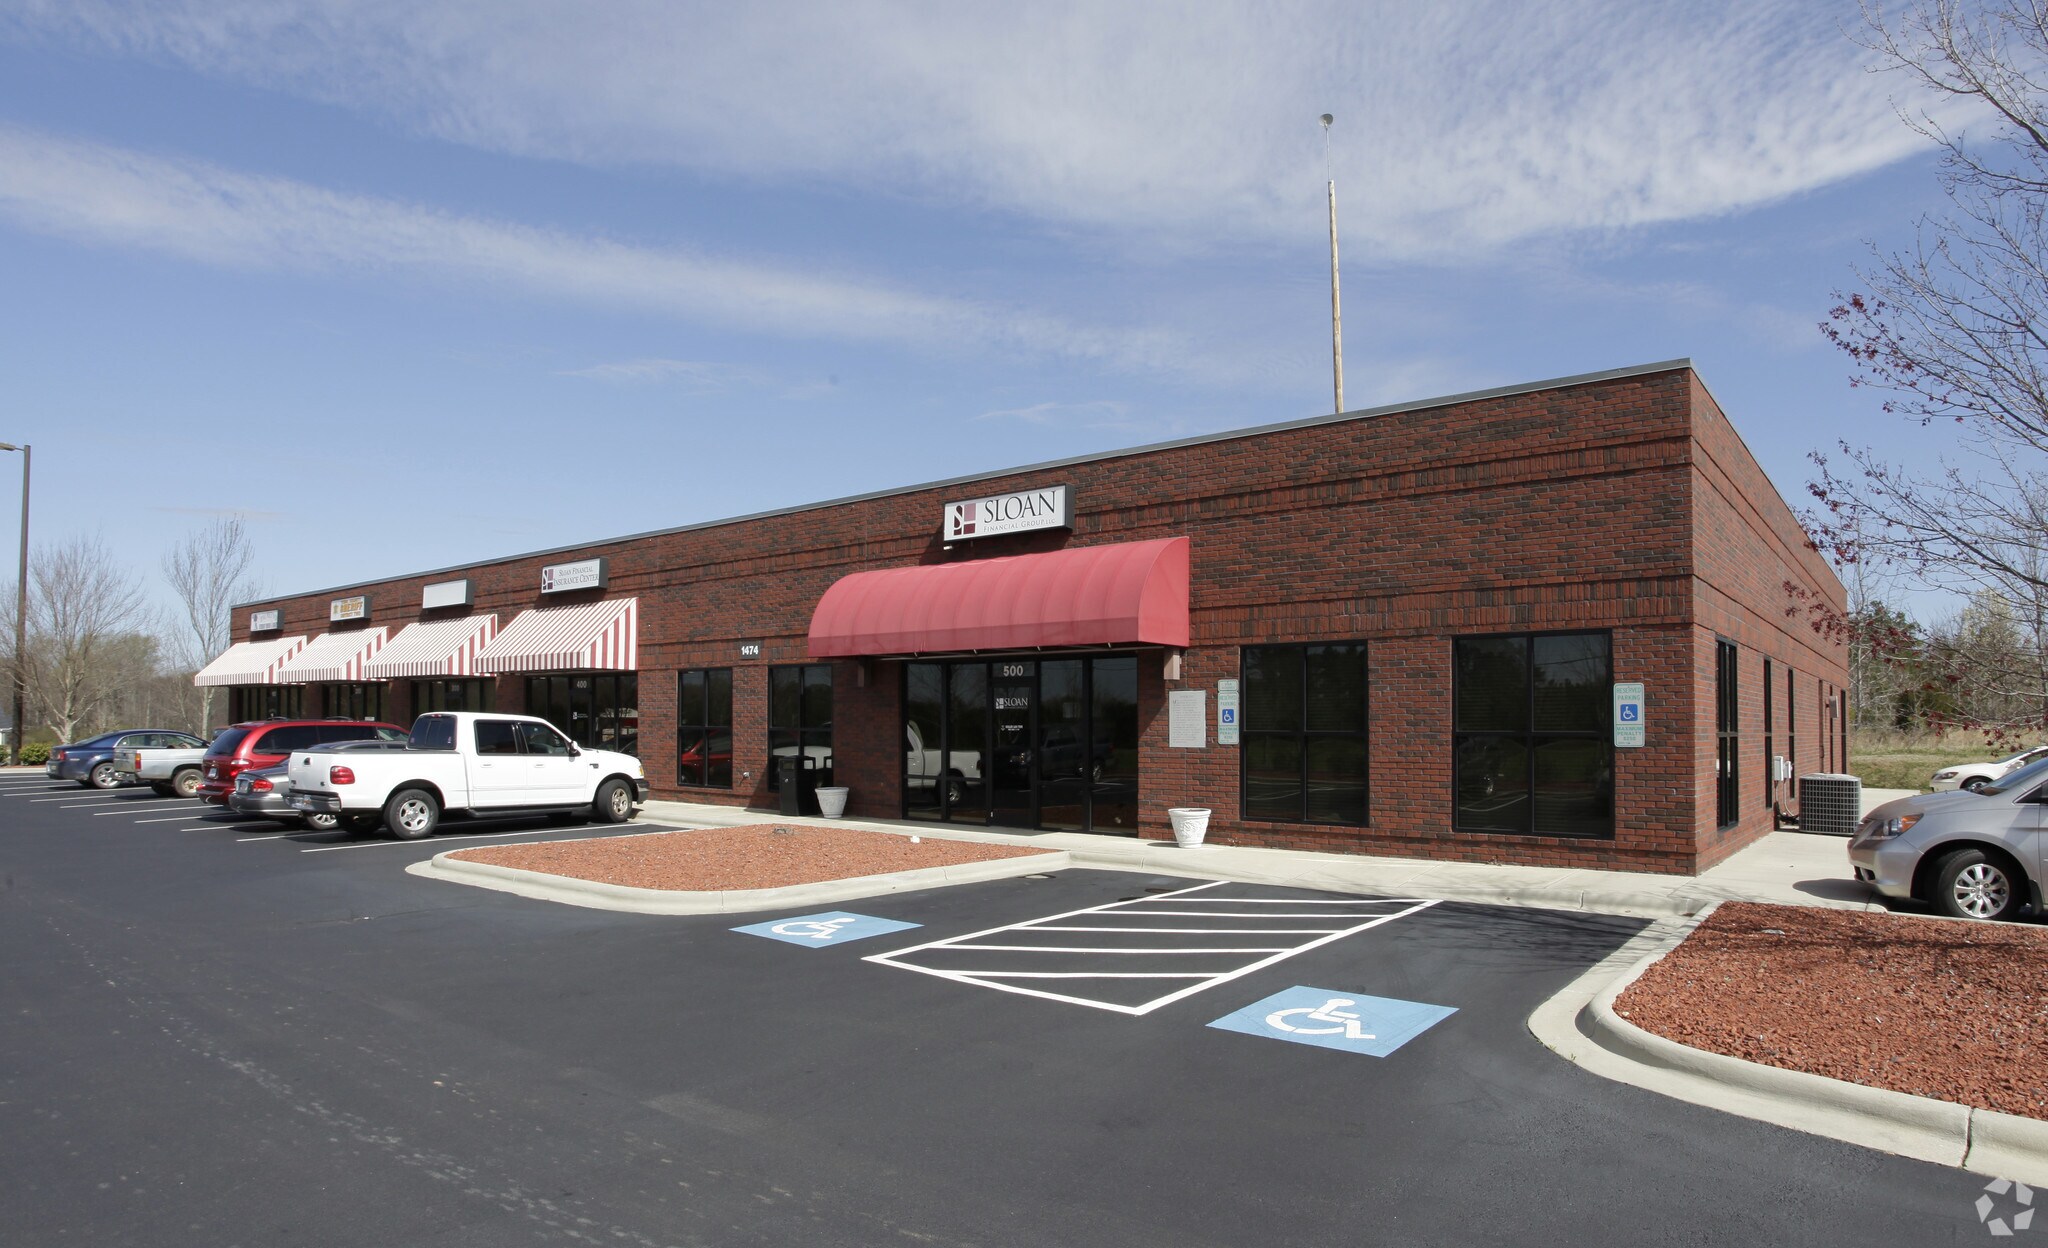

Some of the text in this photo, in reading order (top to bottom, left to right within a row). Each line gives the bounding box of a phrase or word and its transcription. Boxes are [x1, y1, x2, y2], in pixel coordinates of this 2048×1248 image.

[984, 490, 1057, 524] SLOAN
[983, 522, 1019, 533] FINANCIAL
[572, 566, 593, 575] FINANCIAL
[554, 573, 599, 587] INSURANCE CENTER
[741, 645, 759, 655] 1474
[1003, 665, 1024, 677] 500
[576, 680, 587, 689] 400
[1004, 697, 1028, 707] SLOAN
